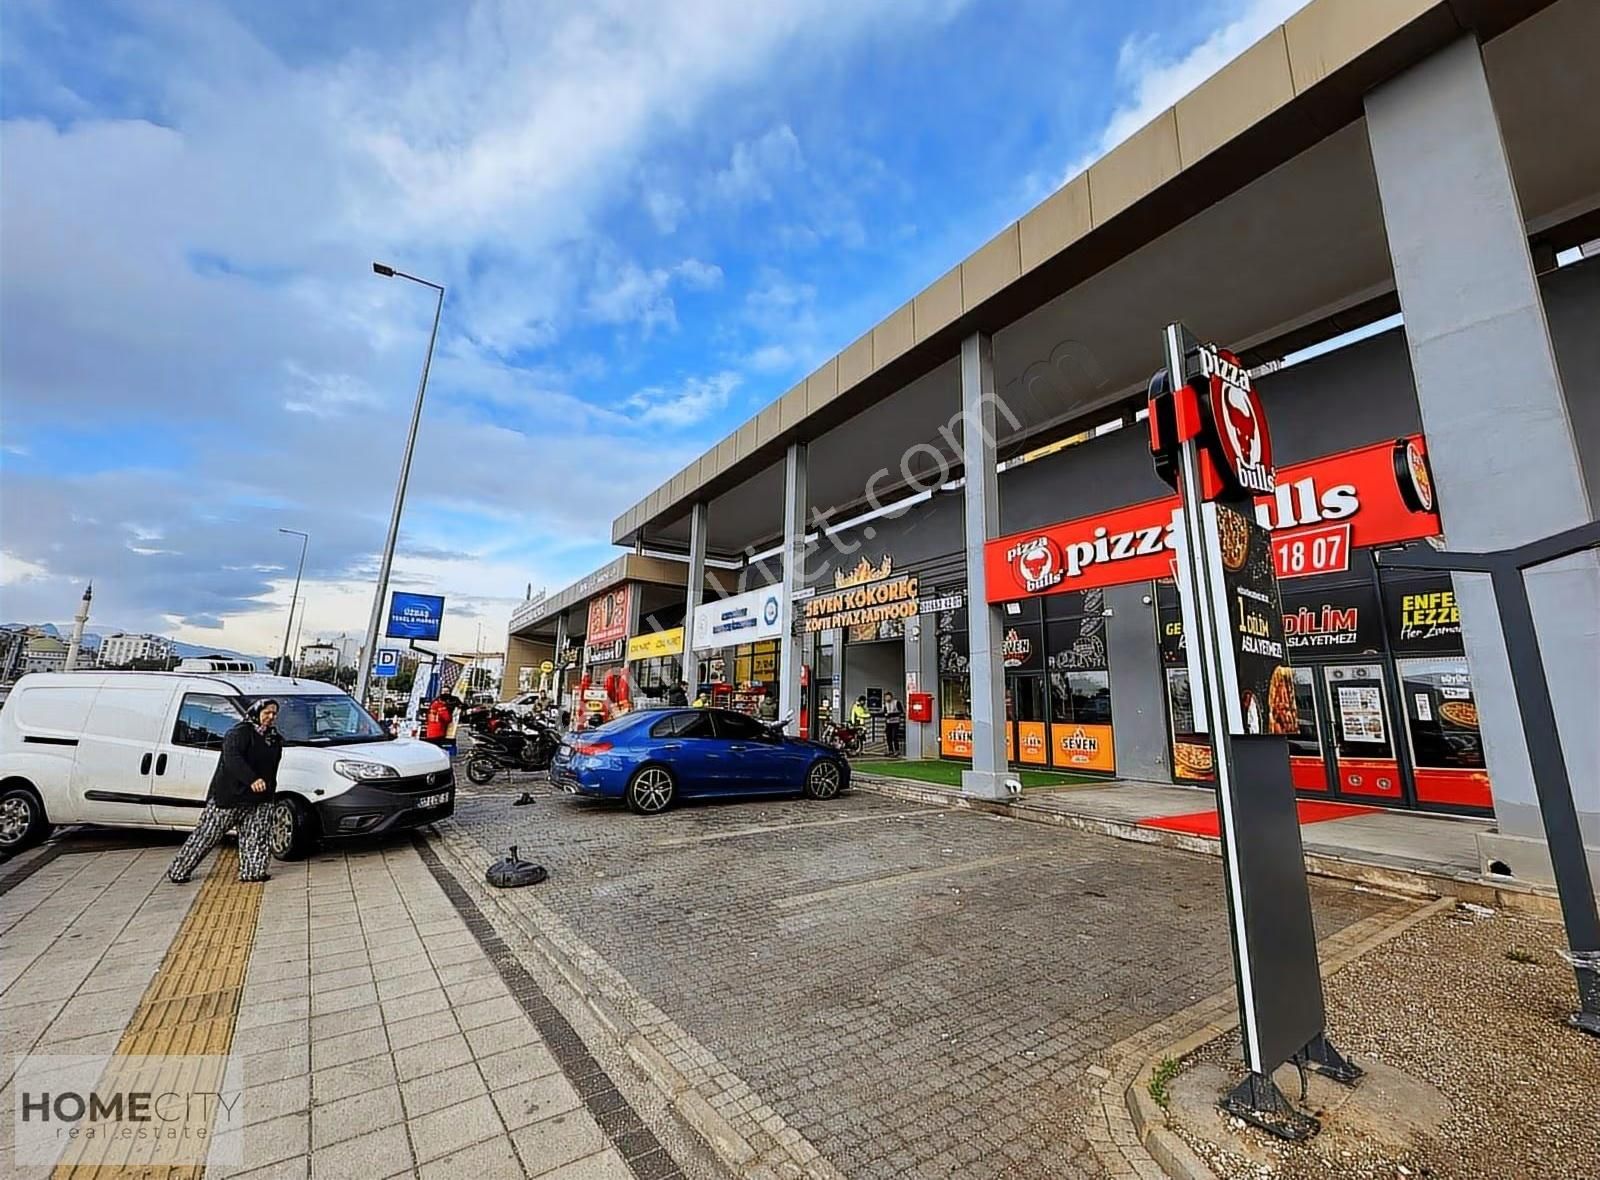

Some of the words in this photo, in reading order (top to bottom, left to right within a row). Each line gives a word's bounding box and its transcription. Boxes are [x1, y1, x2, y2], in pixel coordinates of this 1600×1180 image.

[1200, 345, 1252, 392] pizza
[1007, 537, 1048, 562] pizza
[1278, 541, 1305, 573] 18
[1312, 535, 1342, 570] 07
[804, 594, 844, 617] SEVEN
[844, 577, 918, 609] KOKOREÇ
[1402, 591, 1457, 611] ENFE
[1237, 596, 1247, 633] 1
[1282, 604, 1358, 636] DİLİM
[1286, 636, 1309, 648] SLA
[1401, 623, 1422, 640] Her
[1001, 639, 1030, 655] EVEN
[382, 652, 394, 665] D
[1061, 735, 1098, 751] SEVEN
